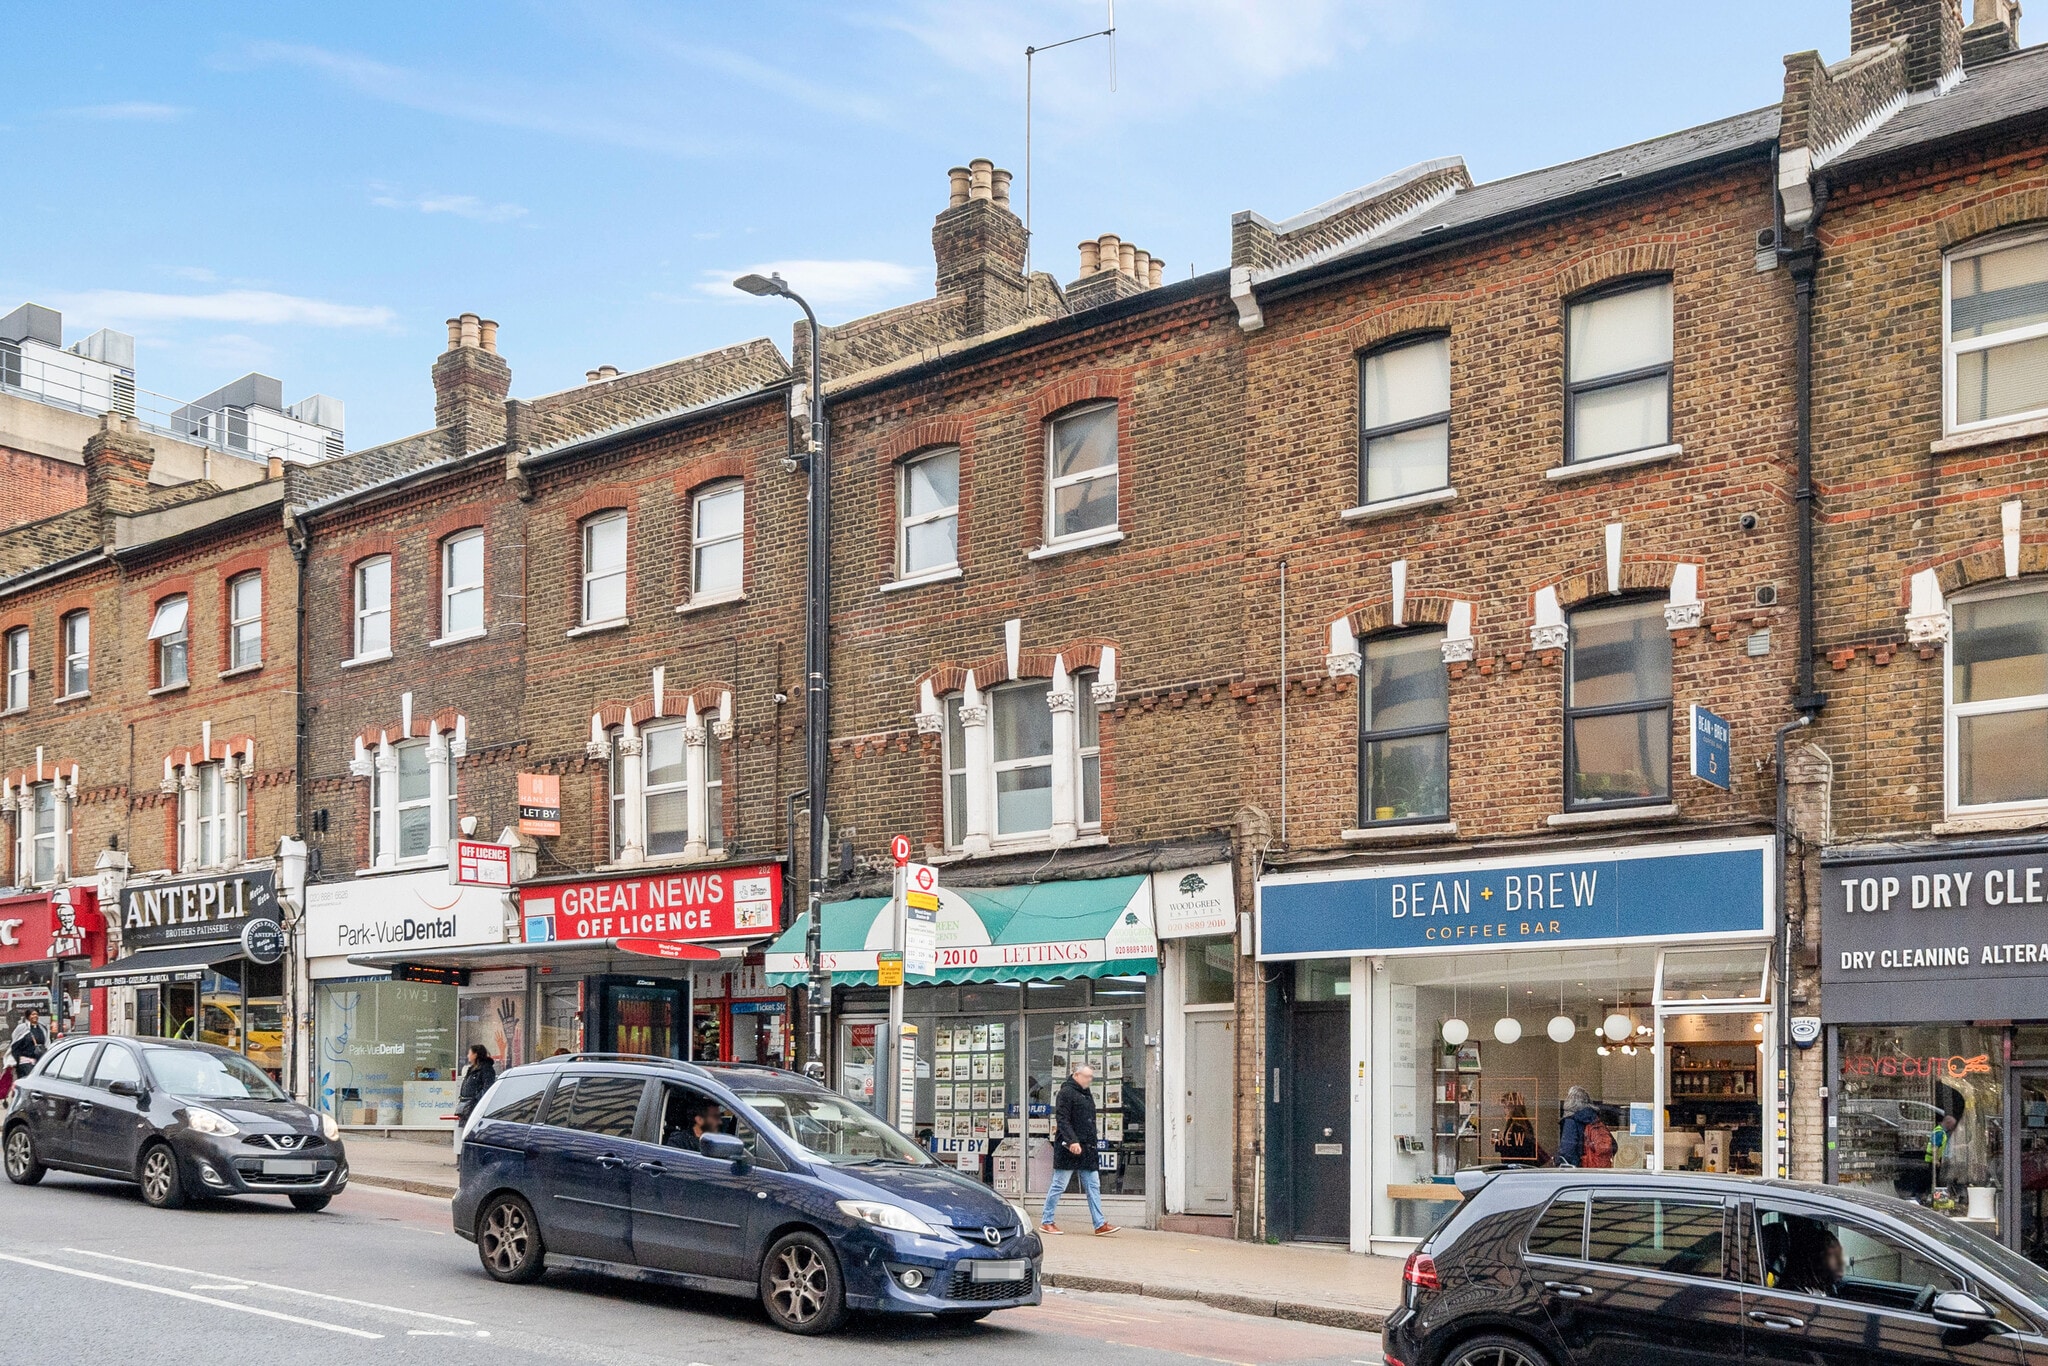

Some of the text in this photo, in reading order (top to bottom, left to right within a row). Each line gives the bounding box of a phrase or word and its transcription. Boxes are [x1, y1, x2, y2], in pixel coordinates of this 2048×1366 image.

[1698, 714, 1711, 735] BEAN
[1713, 723, 1728, 743] BREW
[521, 795, 557, 804] HANLEY
[523, 807, 557, 818] LET BY
[461, 845, 507, 861] OFF LICENCE
[897, 838, 909, 858] D
[758, 865, 771, 875] 202
[561, 874, 724, 916] GREAT NEWS
[1392, 879, 1470, 919] BEAN
[1505, 869, 1598, 912] BREW
[1840, 866, 2048, 913] TOP DRY CLE
[124, 878, 245, 929] ANTEPLI
[1169, 898, 1221, 911] WOOD GREEN
[1169, 908, 1222, 917] ESTATES
[165, 923, 230, 938] BROTHERS PATISSERIE
[338, 914, 457, 946] Park-VueDental
[577, 909, 712, 938] OFF LICENCE
[935, 919, 960, 931] REEN
[1167, 919, 1226, 932] 020 8889 2010
[1425, 920, 1561, 940] COFFEE BAR
[943, 948, 978, 966] 2010
[1003, 942, 1089, 964] LETTINGS
[1115, 944, 1154, 955] 020 8889 2010
[793, 953, 837, 969] SAES
[1840, 950, 1876, 970] DRY
[1880, 946, 1970, 969] CLEANING
[755, 1003, 775, 1012] Ticket
[349, 1042, 405, 1056] Park-VueDental
[1844, 1055, 1948, 1077] KEYS CUT
[1029, 1105, 1047, 1114] FLATS
[943, 1138, 984, 1152] LET BY
